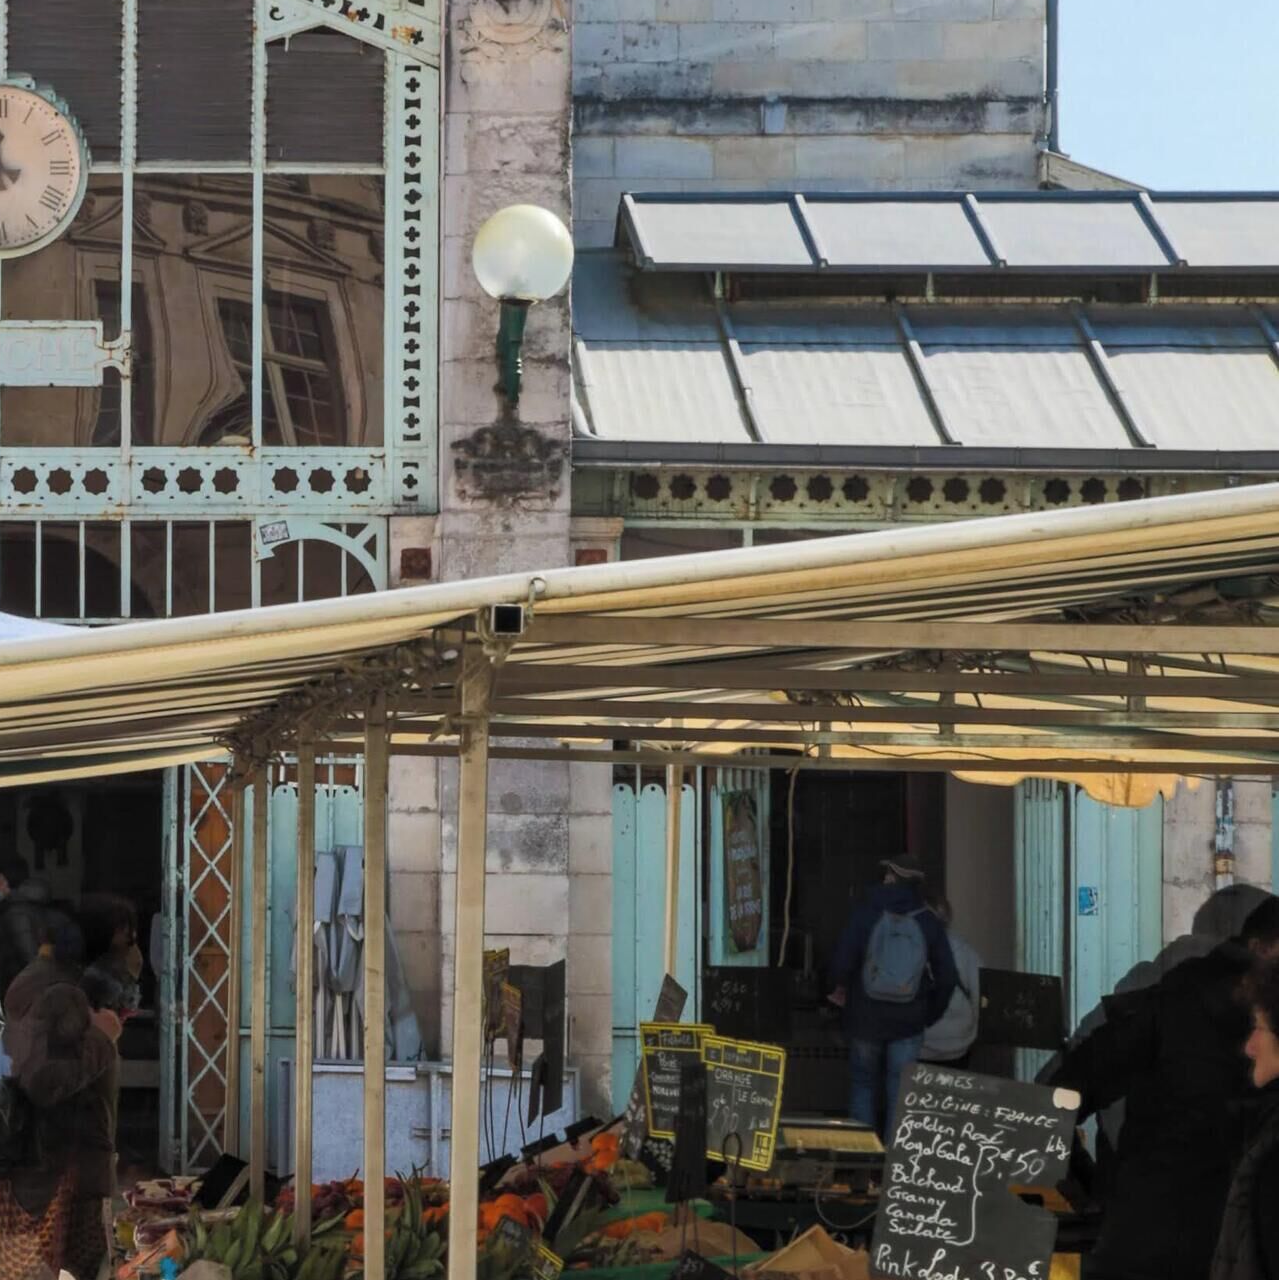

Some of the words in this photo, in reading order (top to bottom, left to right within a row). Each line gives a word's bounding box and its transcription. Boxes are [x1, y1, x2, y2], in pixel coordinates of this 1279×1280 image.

[935, 1141, 974, 1167] Gala
[885, 1203, 957, 1227] Canada
[875, 1243, 919, 1277] Pink
